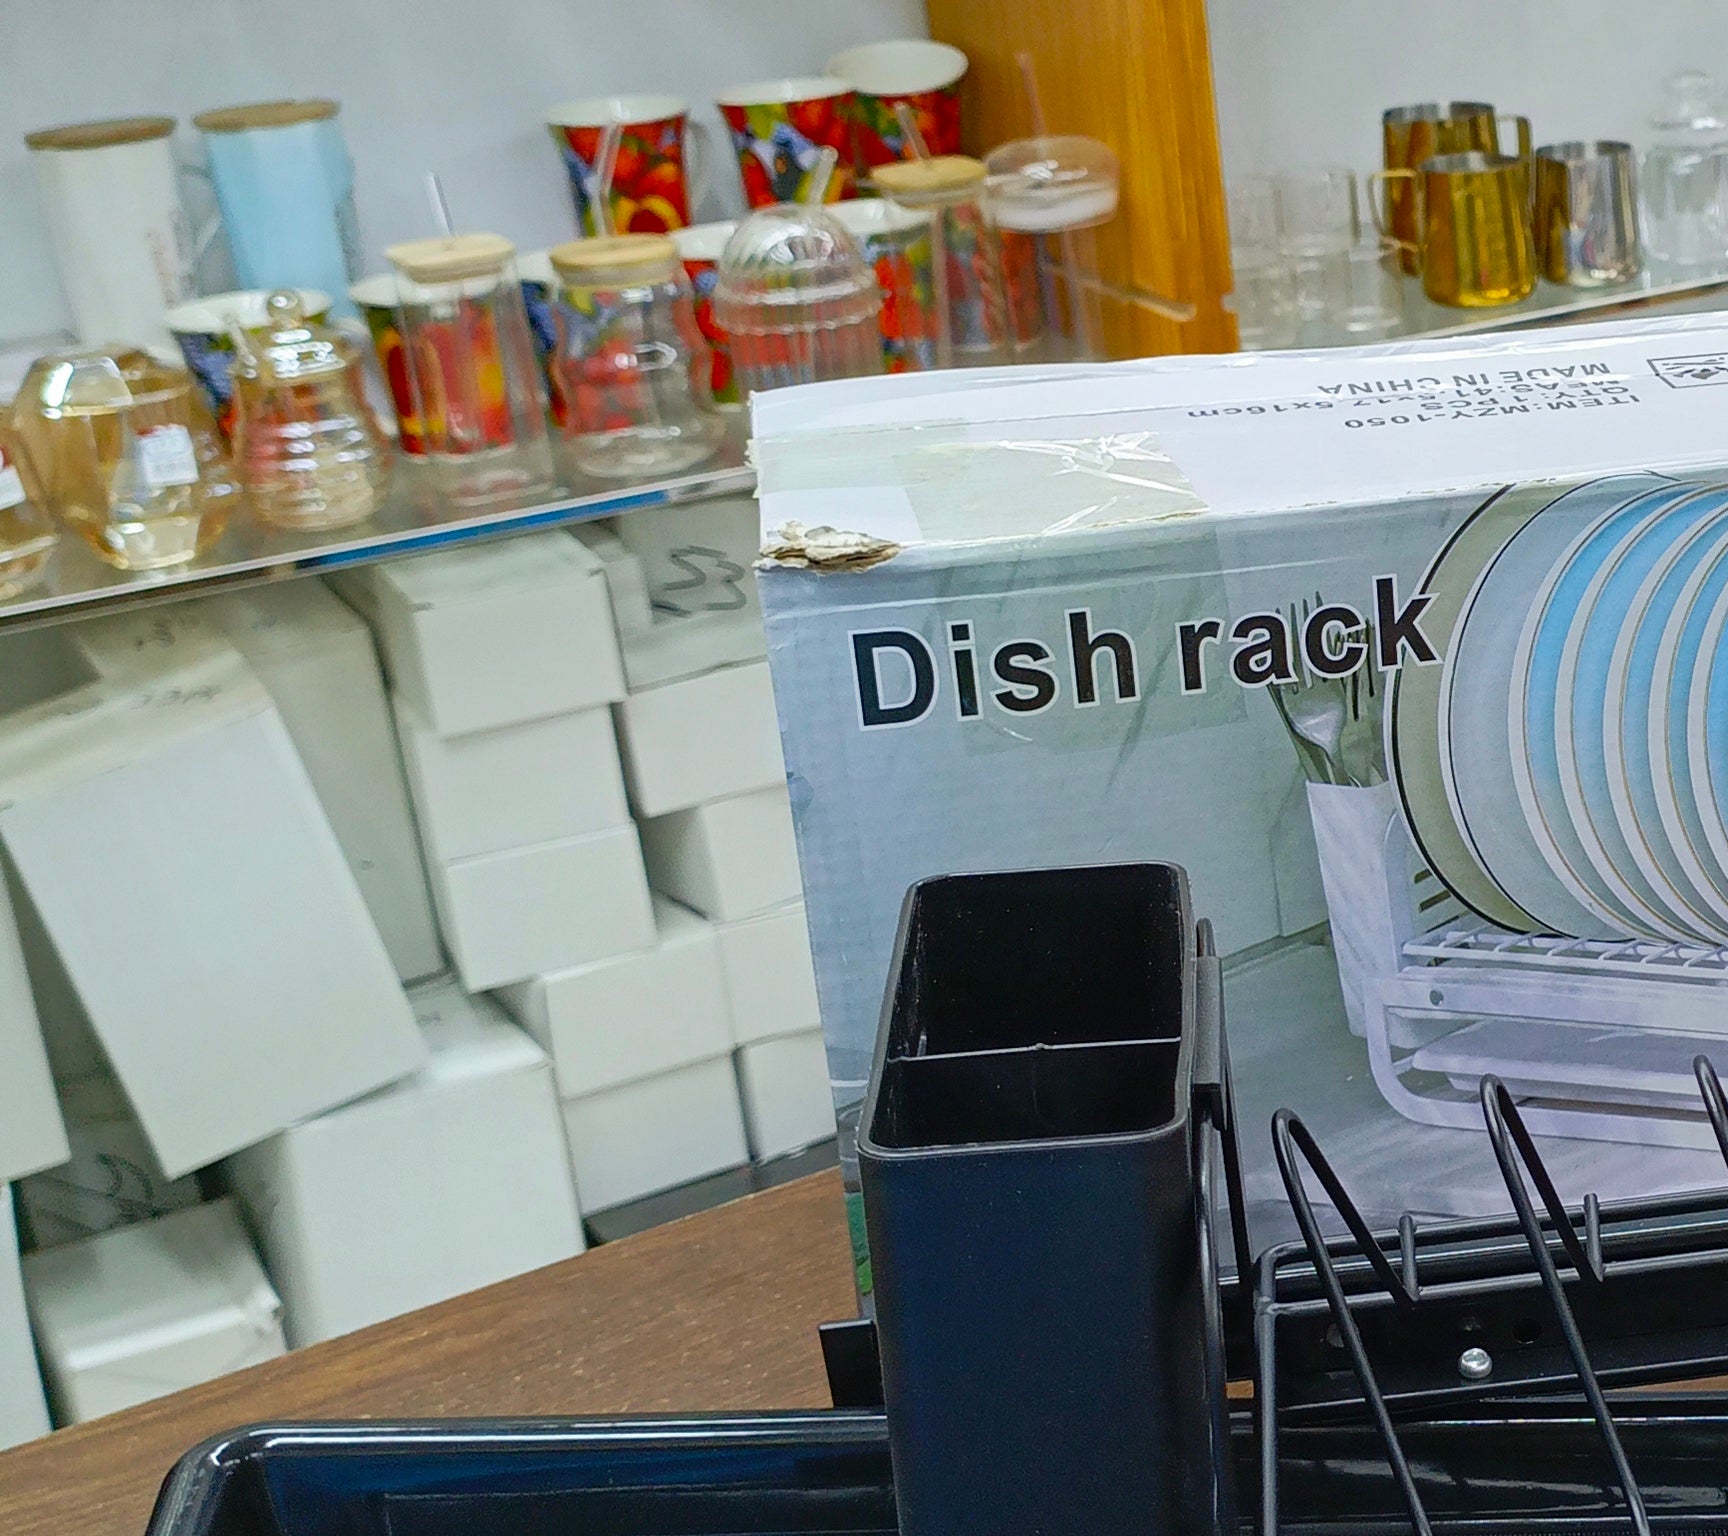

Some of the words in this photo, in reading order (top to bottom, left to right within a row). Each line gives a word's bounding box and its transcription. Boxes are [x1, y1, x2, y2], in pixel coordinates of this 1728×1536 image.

[1452, 372, 1490, 387] IN
[1499, 362, 1611, 384] MADE
[1318, 376, 1441, 395] CHINA
[1541, 386, 1629, 400] QTY:
[1420, 397, 1499, 411] PCS
[849, 608, 1140, 732] Dish
[1174, 573, 1443, 695] rack
